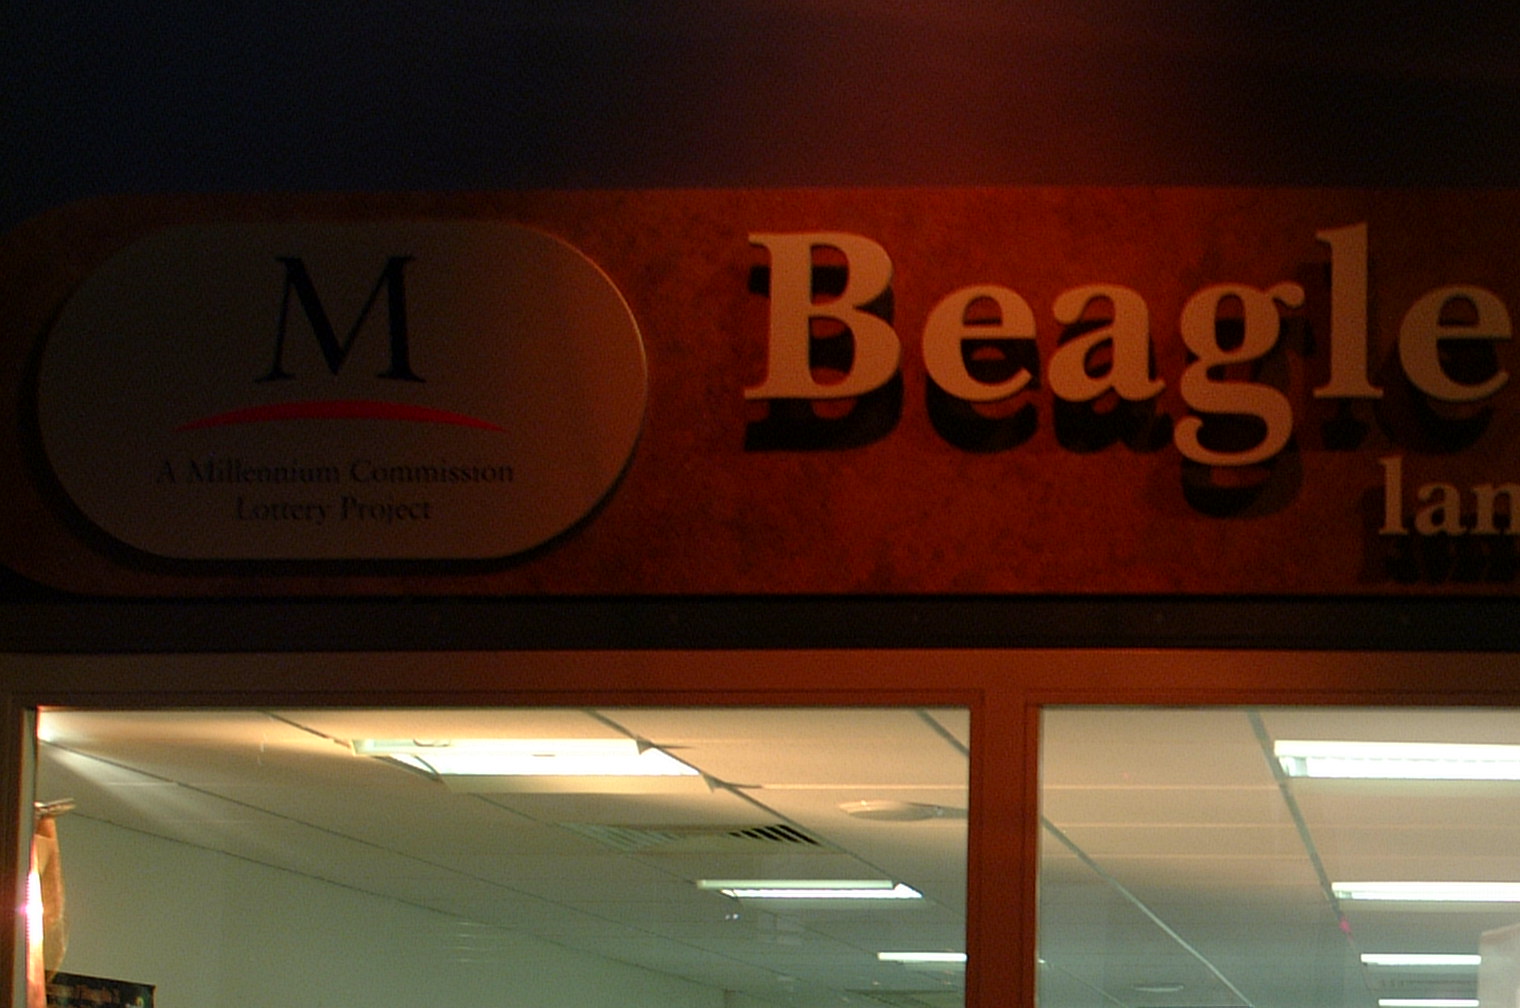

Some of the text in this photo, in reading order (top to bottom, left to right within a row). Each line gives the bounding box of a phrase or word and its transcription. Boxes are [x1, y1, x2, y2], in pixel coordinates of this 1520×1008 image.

[254, 257, 426, 383] M
[744, 222, 1513, 466] Beagle
[156, 459, 514, 484] A Millennium Commission
[236, 495, 432, 525] Lottery Project
